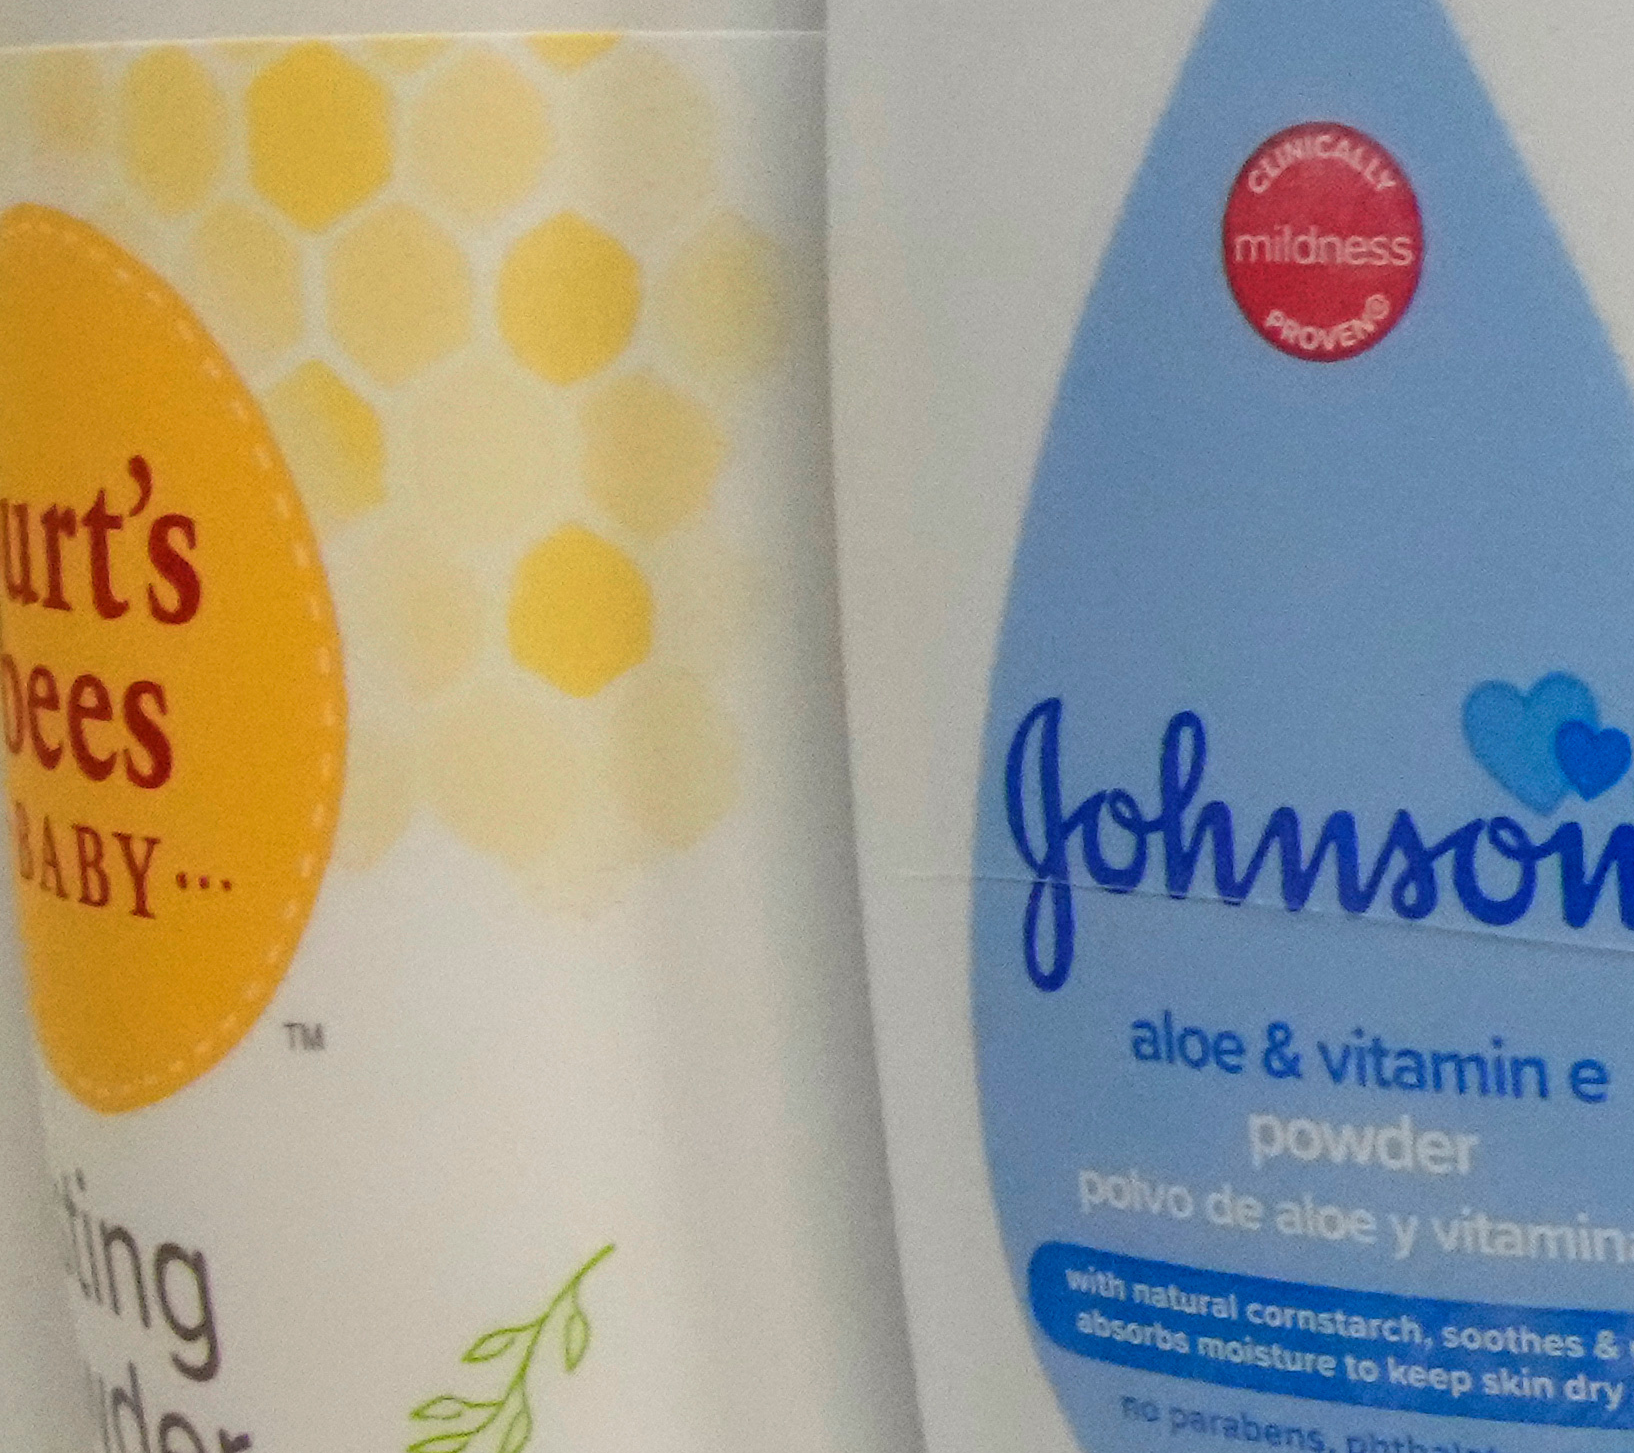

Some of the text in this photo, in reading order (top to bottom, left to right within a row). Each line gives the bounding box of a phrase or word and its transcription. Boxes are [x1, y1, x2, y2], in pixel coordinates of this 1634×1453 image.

[1248, 135, 1397, 194] CLINICALLY
[1234, 223, 1414, 266] mildness
[1131, 1010, 1549, 1100] aloe vitamin
[1248, 1112, 1479, 1176] powder
[1078, 1167, 1193, 1219] polvo
[1206, 1181, 1264, 1232] de
[1275, 1192, 1378, 1242] aloe
[1065, 1264, 1126, 1304] with
[1131, 1278, 1238, 1322] natural
[1246, 1301, 1432, 1348] cornstarch,
[1442, 1321, 1583, 1362] soothes
[1076, 1310, 1189, 1355] absorbs
[1196, 1336, 1336, 1380] moisture
[1344, 1355, 1379, 1384] to
[1388, 1356, 1472, 1398] keep
[1482, 1369, 1553, 1401] skin
[1564, 1372, 1623, 1411] dry
